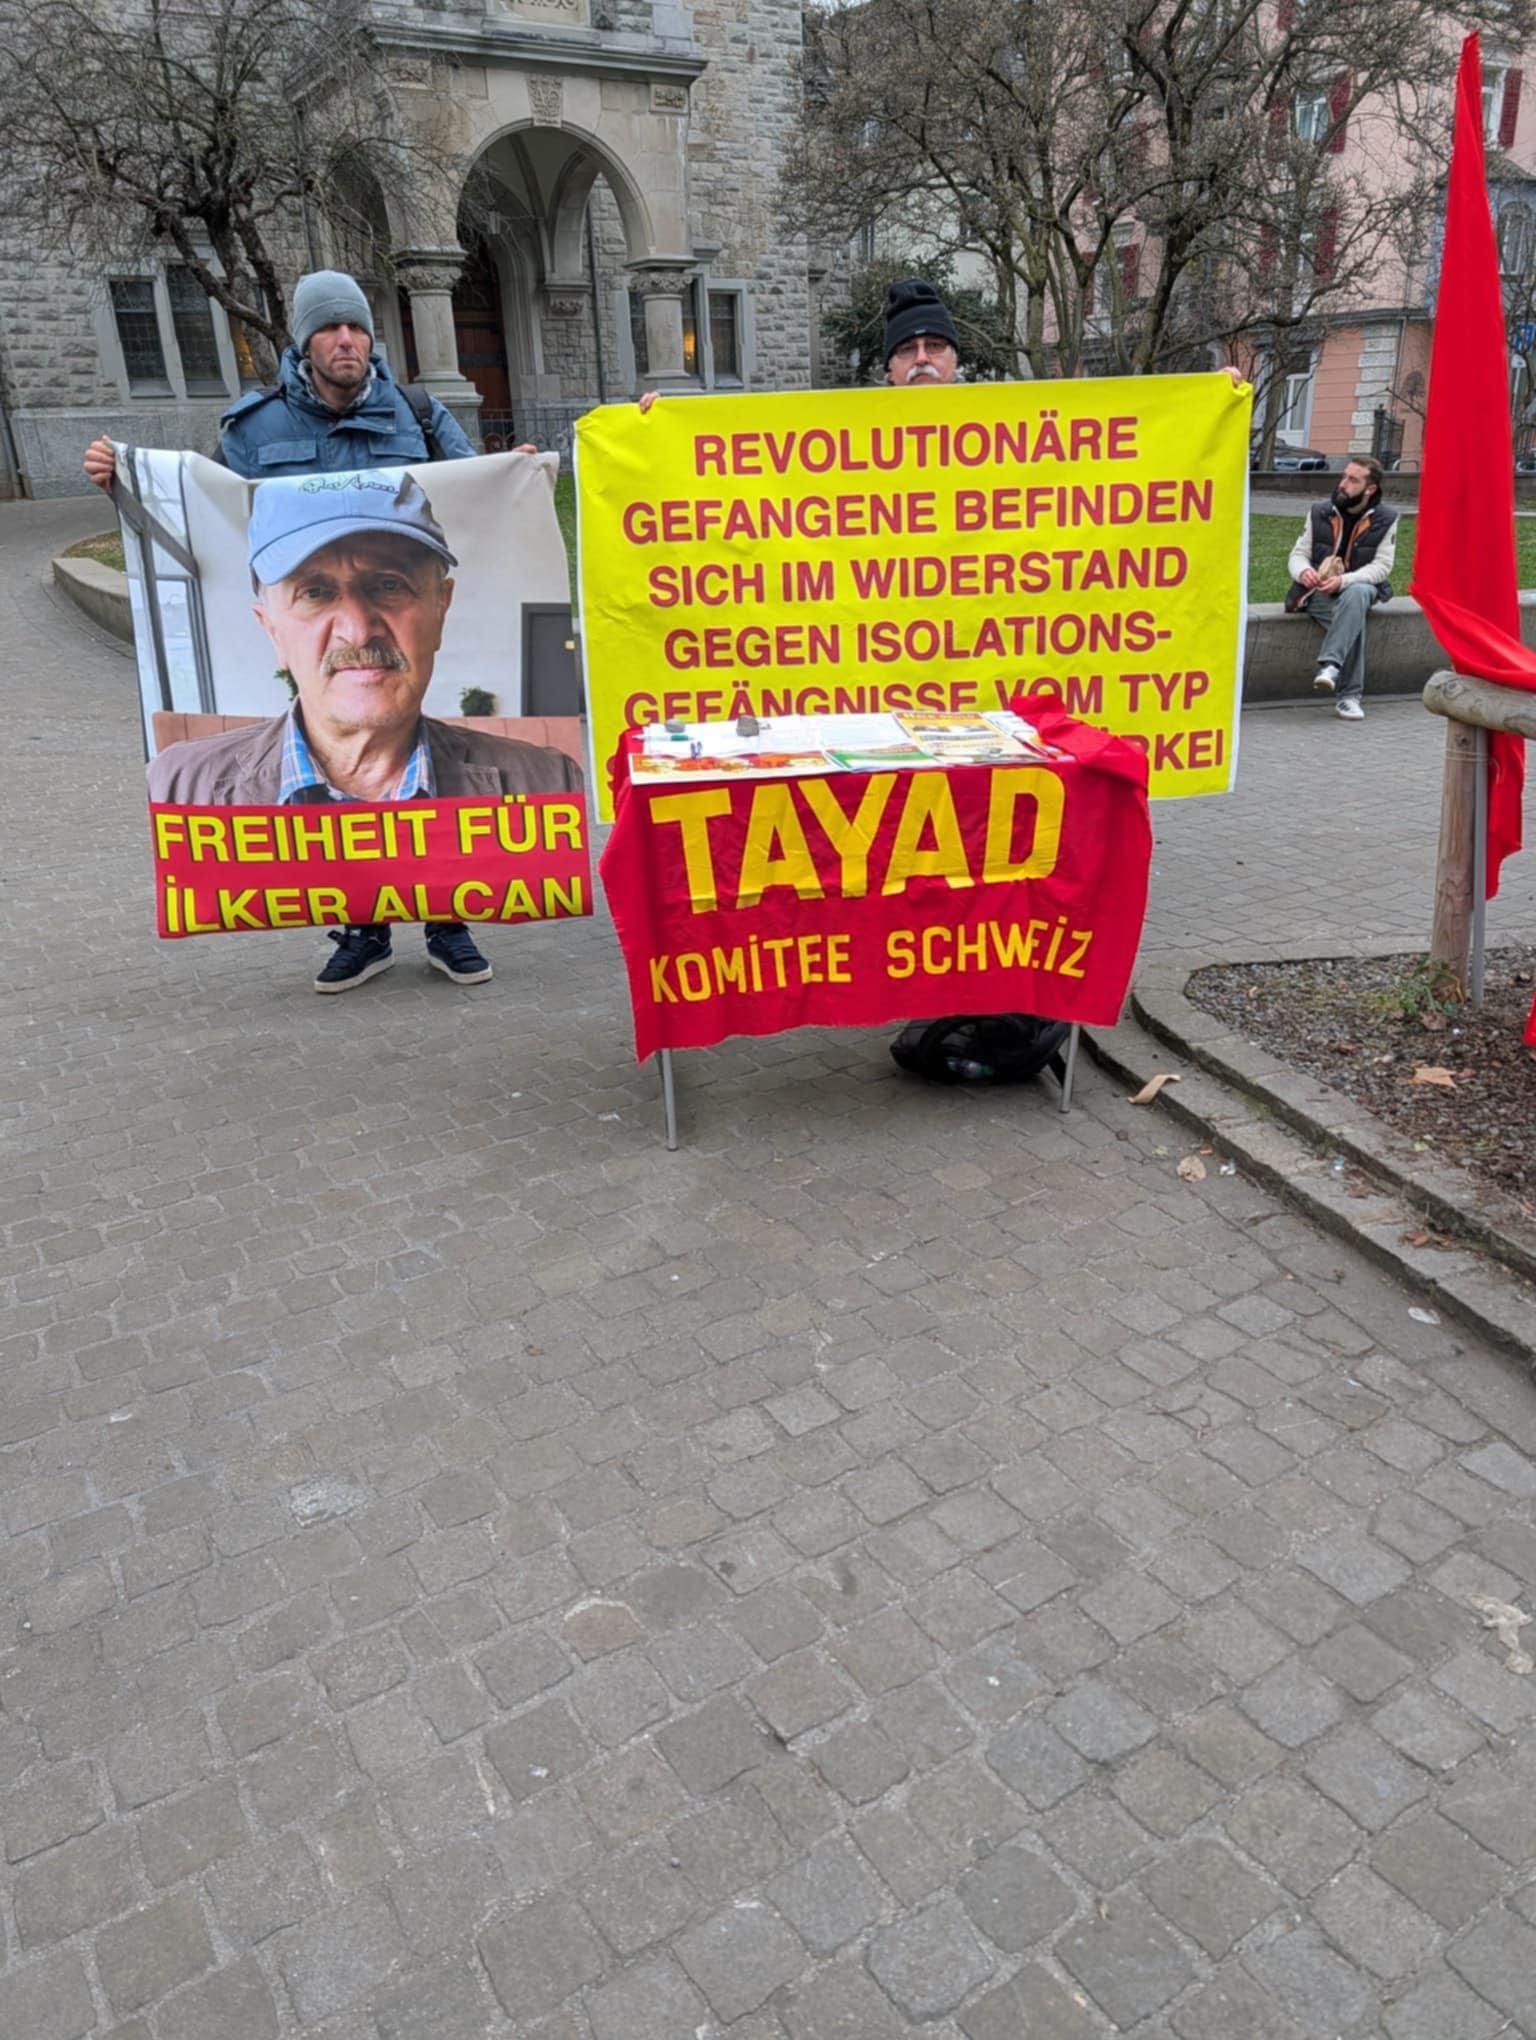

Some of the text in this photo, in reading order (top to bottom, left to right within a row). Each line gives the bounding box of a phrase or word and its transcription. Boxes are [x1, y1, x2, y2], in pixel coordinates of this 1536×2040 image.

[694, 410, 1138, 476] REVOLUTIONÄRE
[622, 479, 1213, 545] GEFANGENE BEFINDEN
[649, 546, 1188, 608] SICH IM WIDERSTAND
[664, 610, 1172, 670] GEGEN ISOLATIONS-
[1119, 670, 1209, 713] TYP
[155, 791, 583, 863] FREIHEIT FÜR
[649, 767, 1066, 914] TAYAD
[372, 876, 583, 923] ALCAN
